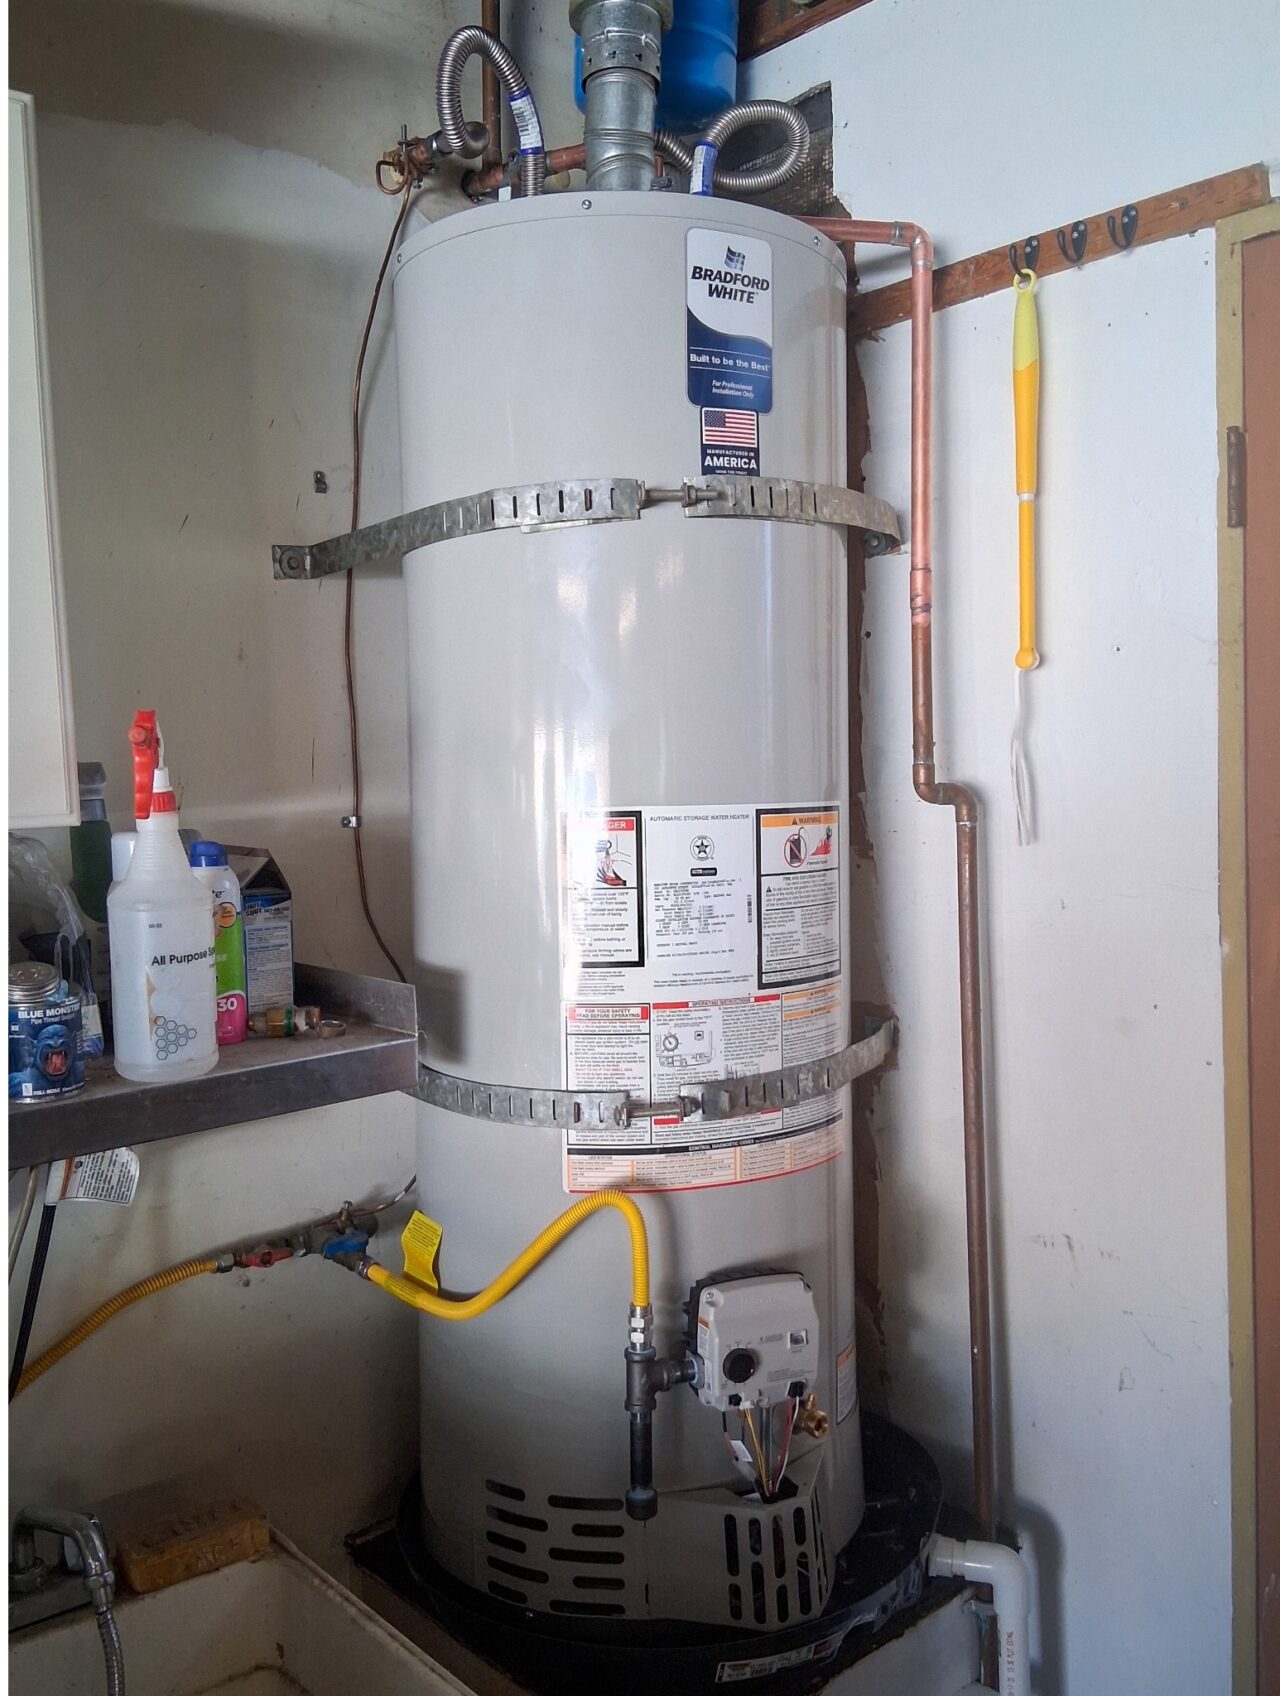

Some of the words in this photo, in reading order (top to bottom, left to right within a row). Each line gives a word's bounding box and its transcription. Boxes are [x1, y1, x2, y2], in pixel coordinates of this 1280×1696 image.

[691, 265, 770, 291] BRADFORD
[708, 283, 755, 304] WHITE
[690, 353, 710, 363] Built
[711, 356, 721, 365] to
[722, 356, 734, 366] be
[736, 359, 749, 369] the
[751, 361, 769, 372] Best
[712, 379, 721, 387] For
[722, 380, 753, 391] Professional
[712, 387, 742, 396] Installation
[742, 391, 755, 400] Only
[706, 448, 748, 457] MANUFACTURED
[704, 455, 757, 470] AMERICA
[151, 955, 166, 966] All
[169, 949, 208, 965] Purpose
[217, 997, 238, 1012] 30
[17, 1009, 44, 1019] BLUE
